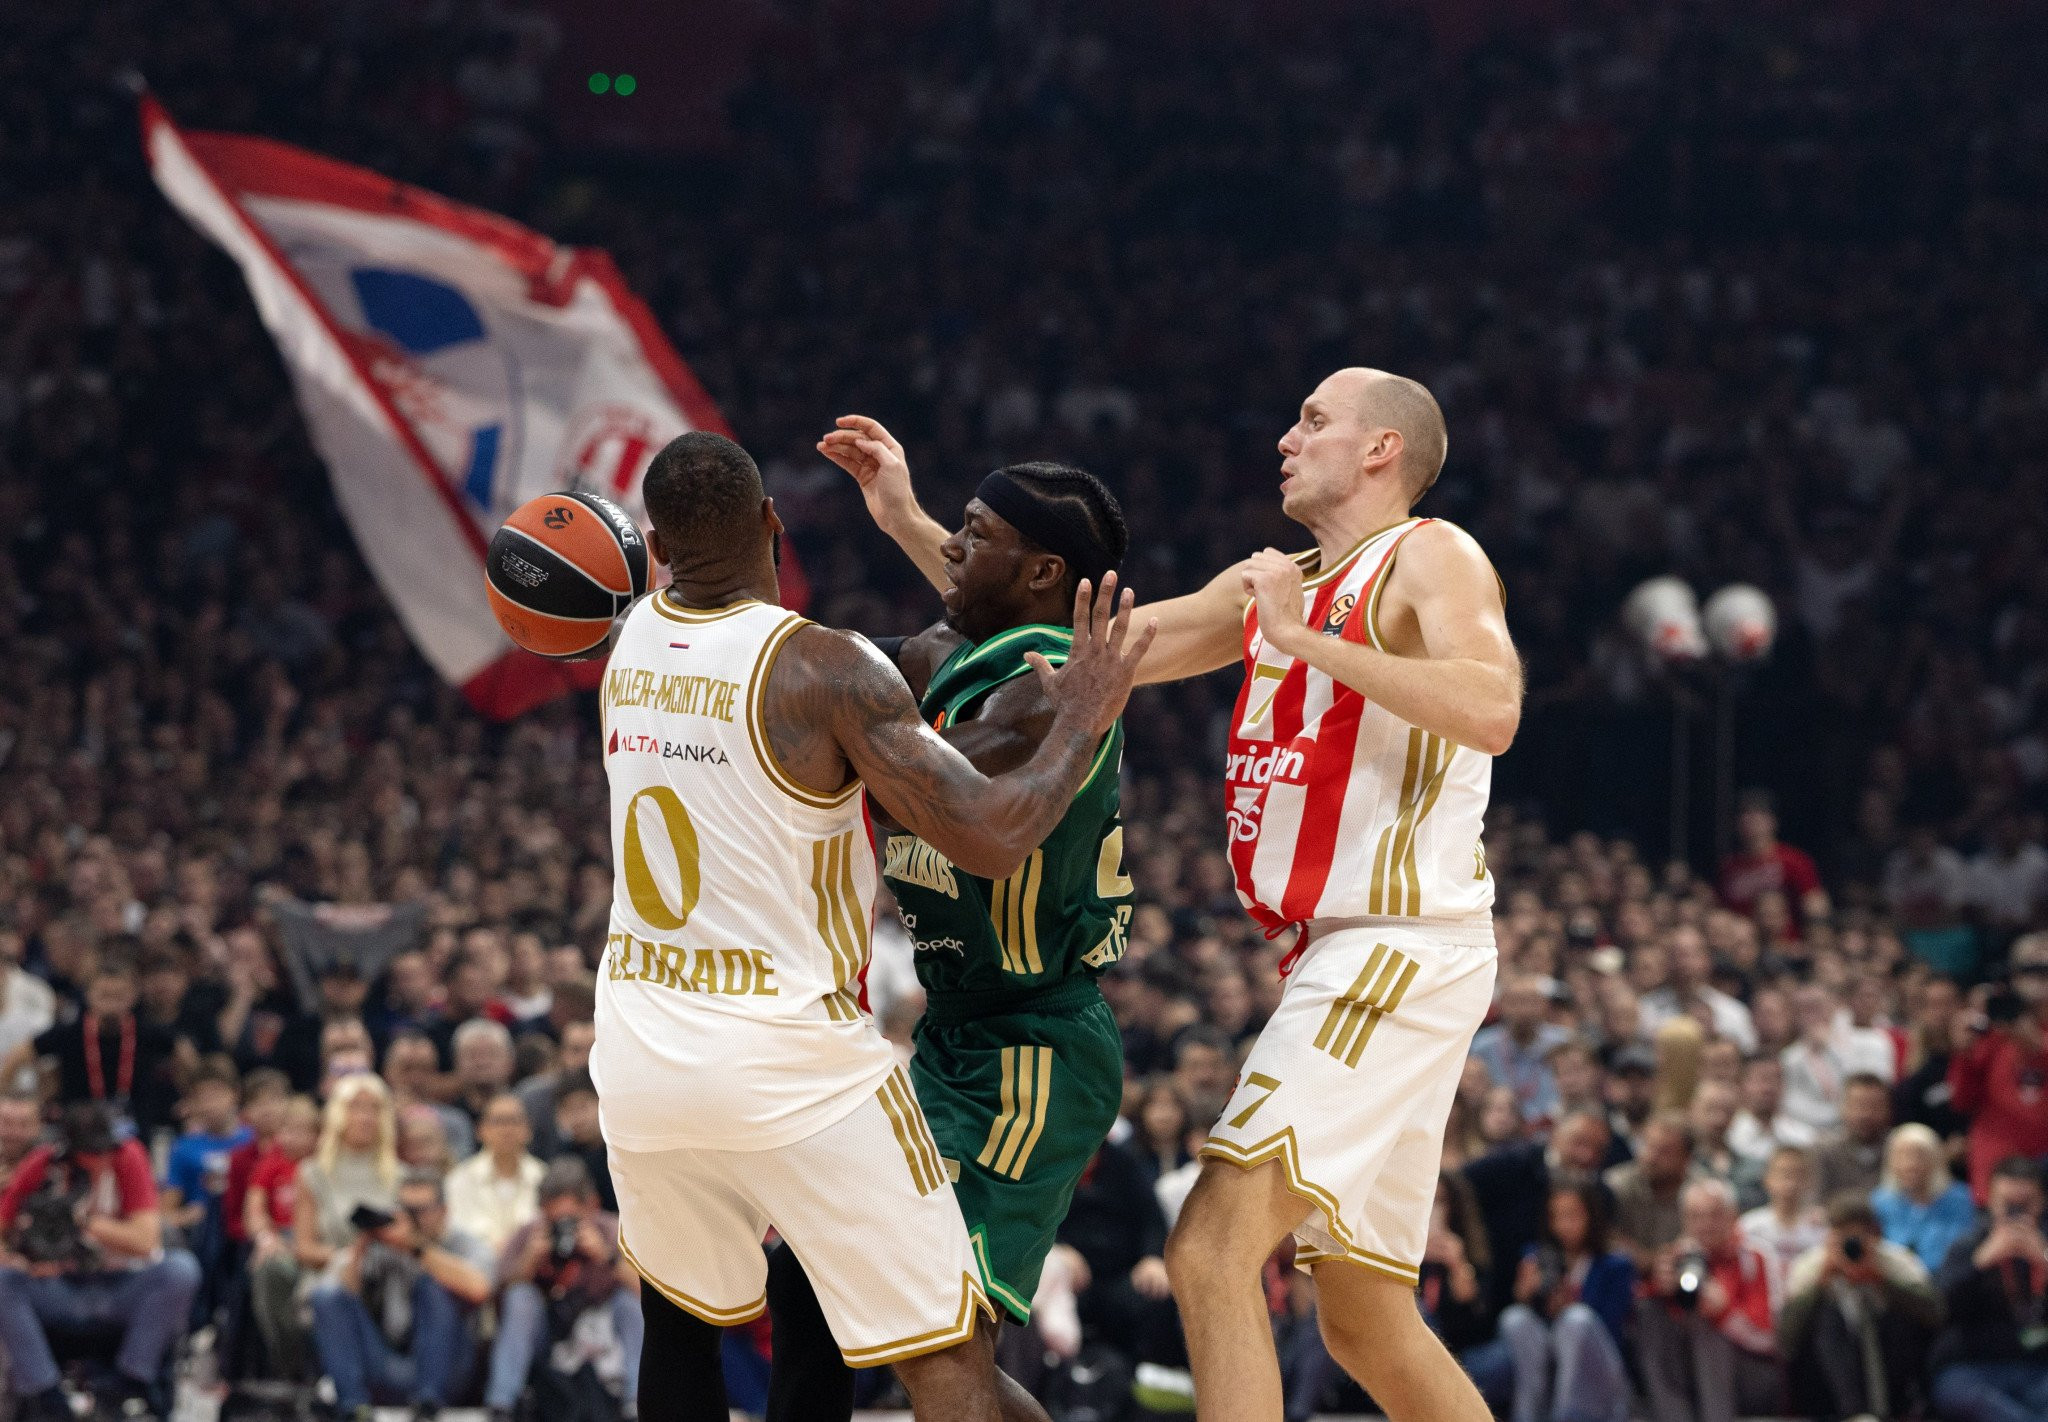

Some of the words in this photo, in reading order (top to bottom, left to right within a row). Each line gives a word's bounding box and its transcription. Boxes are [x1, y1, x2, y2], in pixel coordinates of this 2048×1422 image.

[608, 668, 741, 723] MLLER-MCINTYRE
[1246, 662, 1290, 725] 7
[621, 735, 660, 754] ALTA
[663, 741, 731, 766] BANKA
[623, 785, 700, 931] 0
[1227, 1071, 1282, 1129] 7
